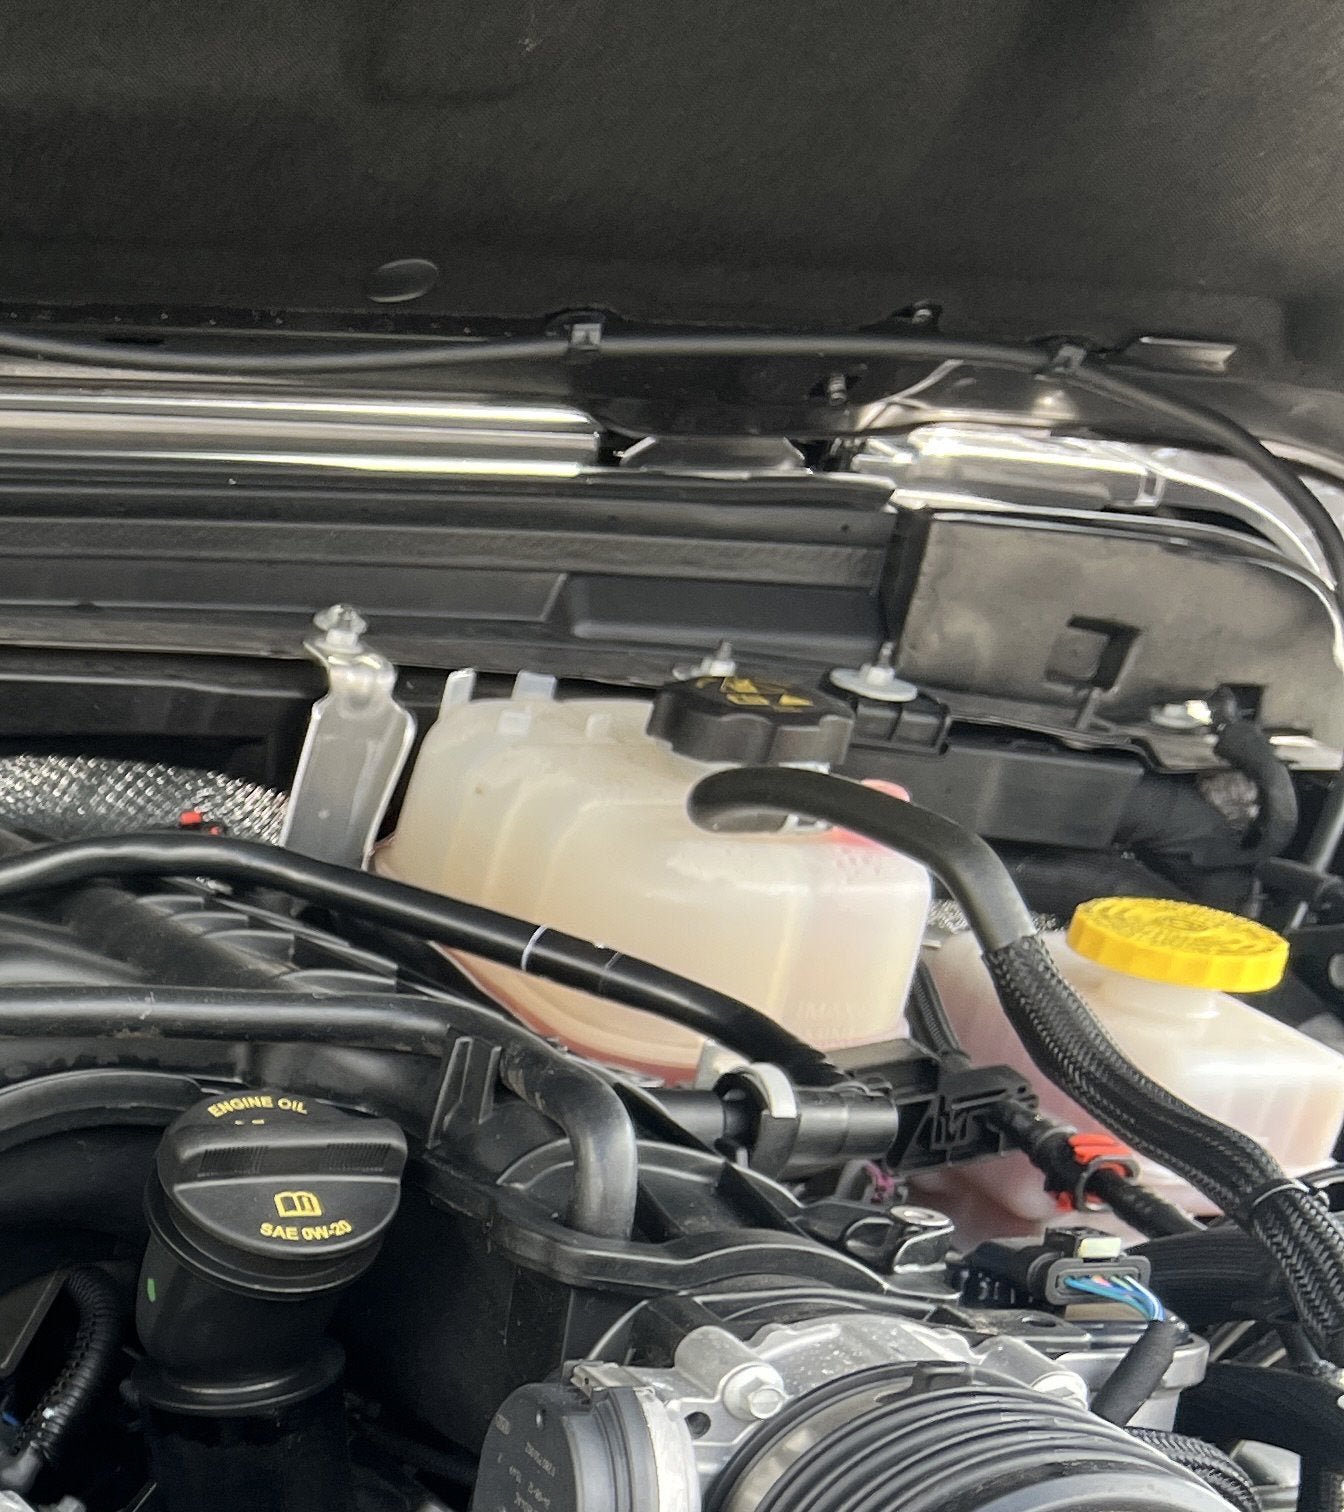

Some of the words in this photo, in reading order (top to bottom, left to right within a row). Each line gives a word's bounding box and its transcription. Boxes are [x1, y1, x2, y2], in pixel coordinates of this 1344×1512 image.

[208, 1095, 273, 1118] ENGINE
[278, 1097, 308, 1115] OIL
[260, 1222, 300, 1241] SAE
[301, 1219, 353, 1241] 0W-20
